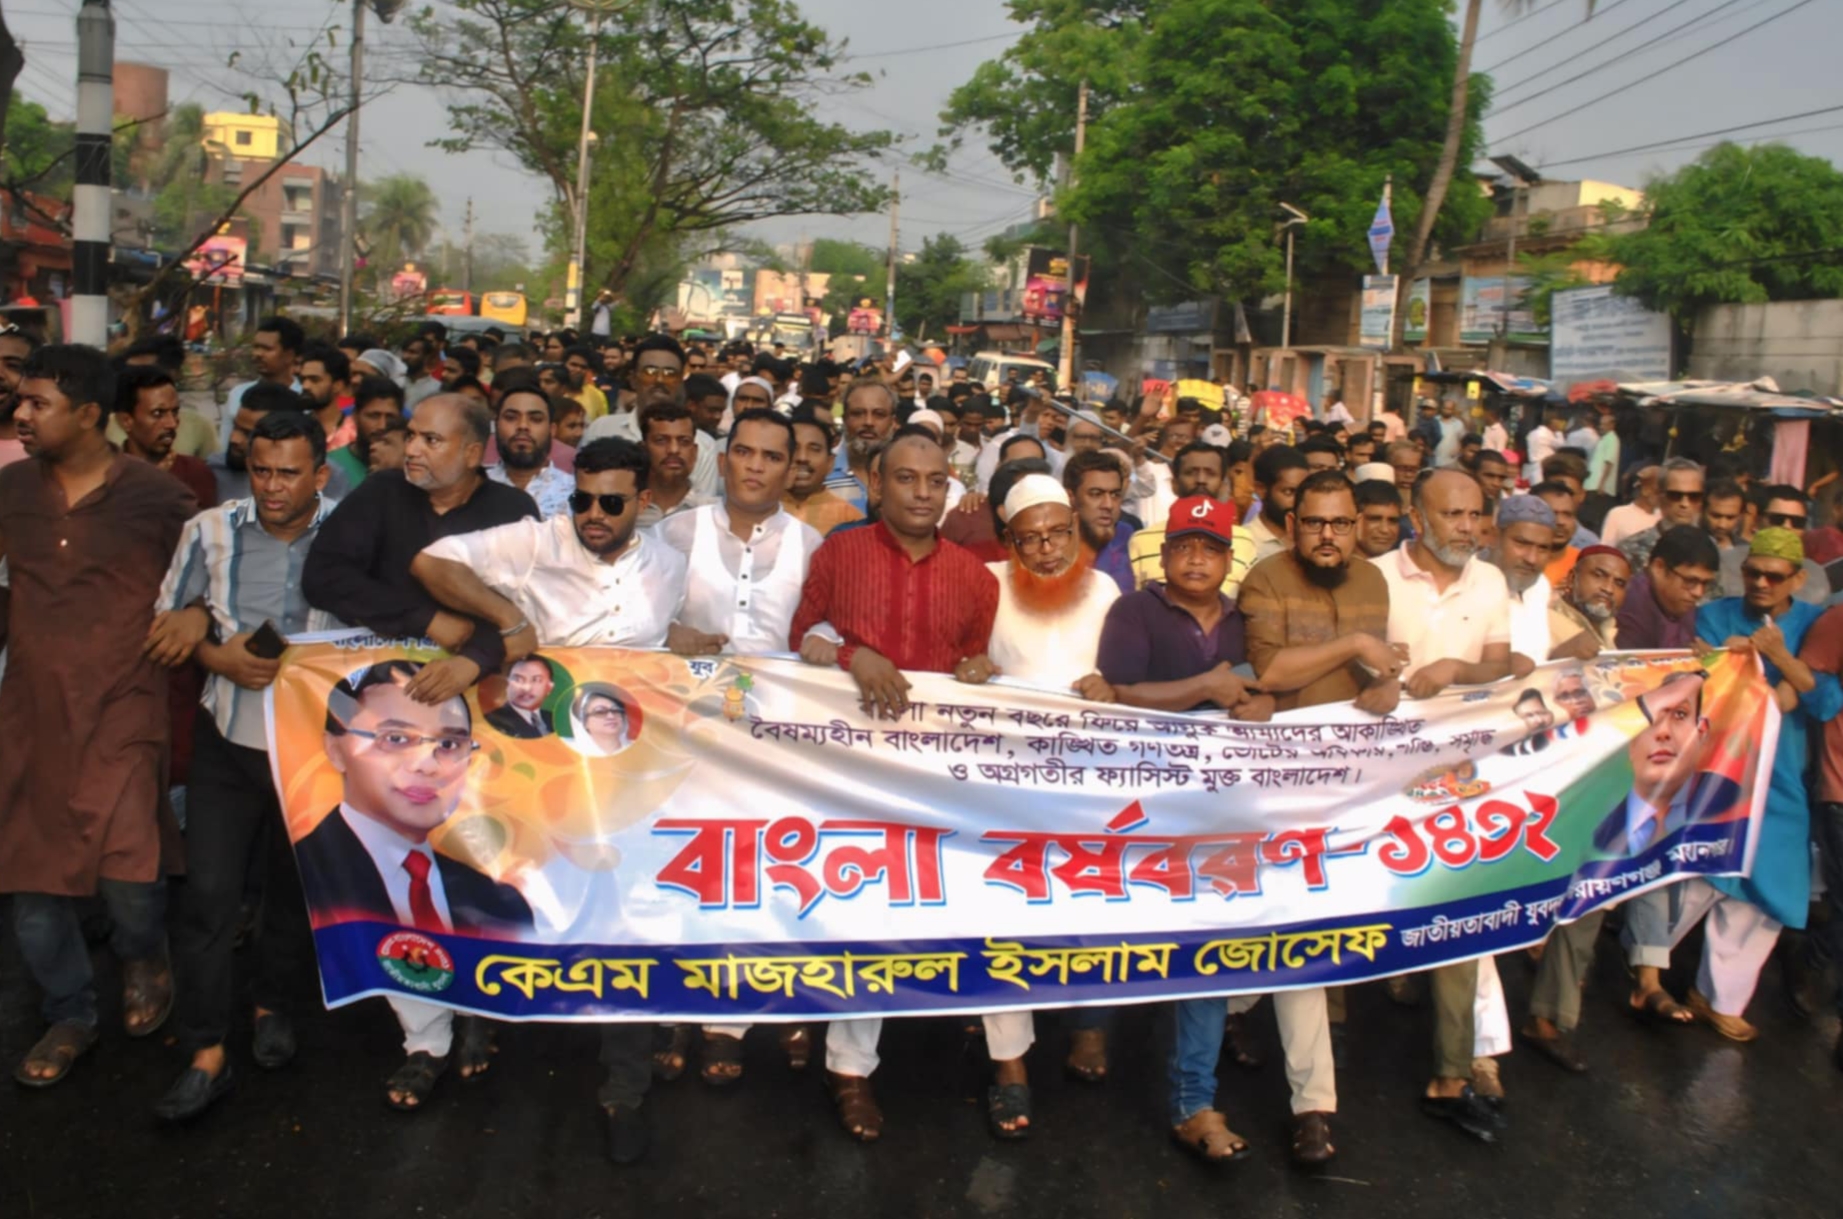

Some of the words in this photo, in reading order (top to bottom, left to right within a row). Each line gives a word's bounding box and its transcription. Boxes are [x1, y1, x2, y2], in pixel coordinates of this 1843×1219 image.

[748, 714, 873, 748] বৈষম্যহীন
[881, 728, 1015, 760] বাংলাদেশ,
[934, 702, 997, 731] নতুন
[1008, 708, 1070, 730] বছরে
[1080, 709, 1139, 732] ফিরে
[947, 763, 969, 781] ও
[976, 757, 1087, 785] অগ্রগতীর
[1094, 761, 1193, 788] ফ্যাসিস্ট
[1199, 769, 1242, 793] মুক্ত
[651, 816, 958, 920] বাংলা
[474, 954, 660, 1000] কেএম
[672, 950, 968, 1000] মাজহারুল
[980, 937, 1180, 990] ইসলাম
[1194, 923, 1393, 976] জোসেফ
[1400, 901, 1522, 947] জাতীয়তাবাদী
[1525, 892, 1565, 926] যুবদ
